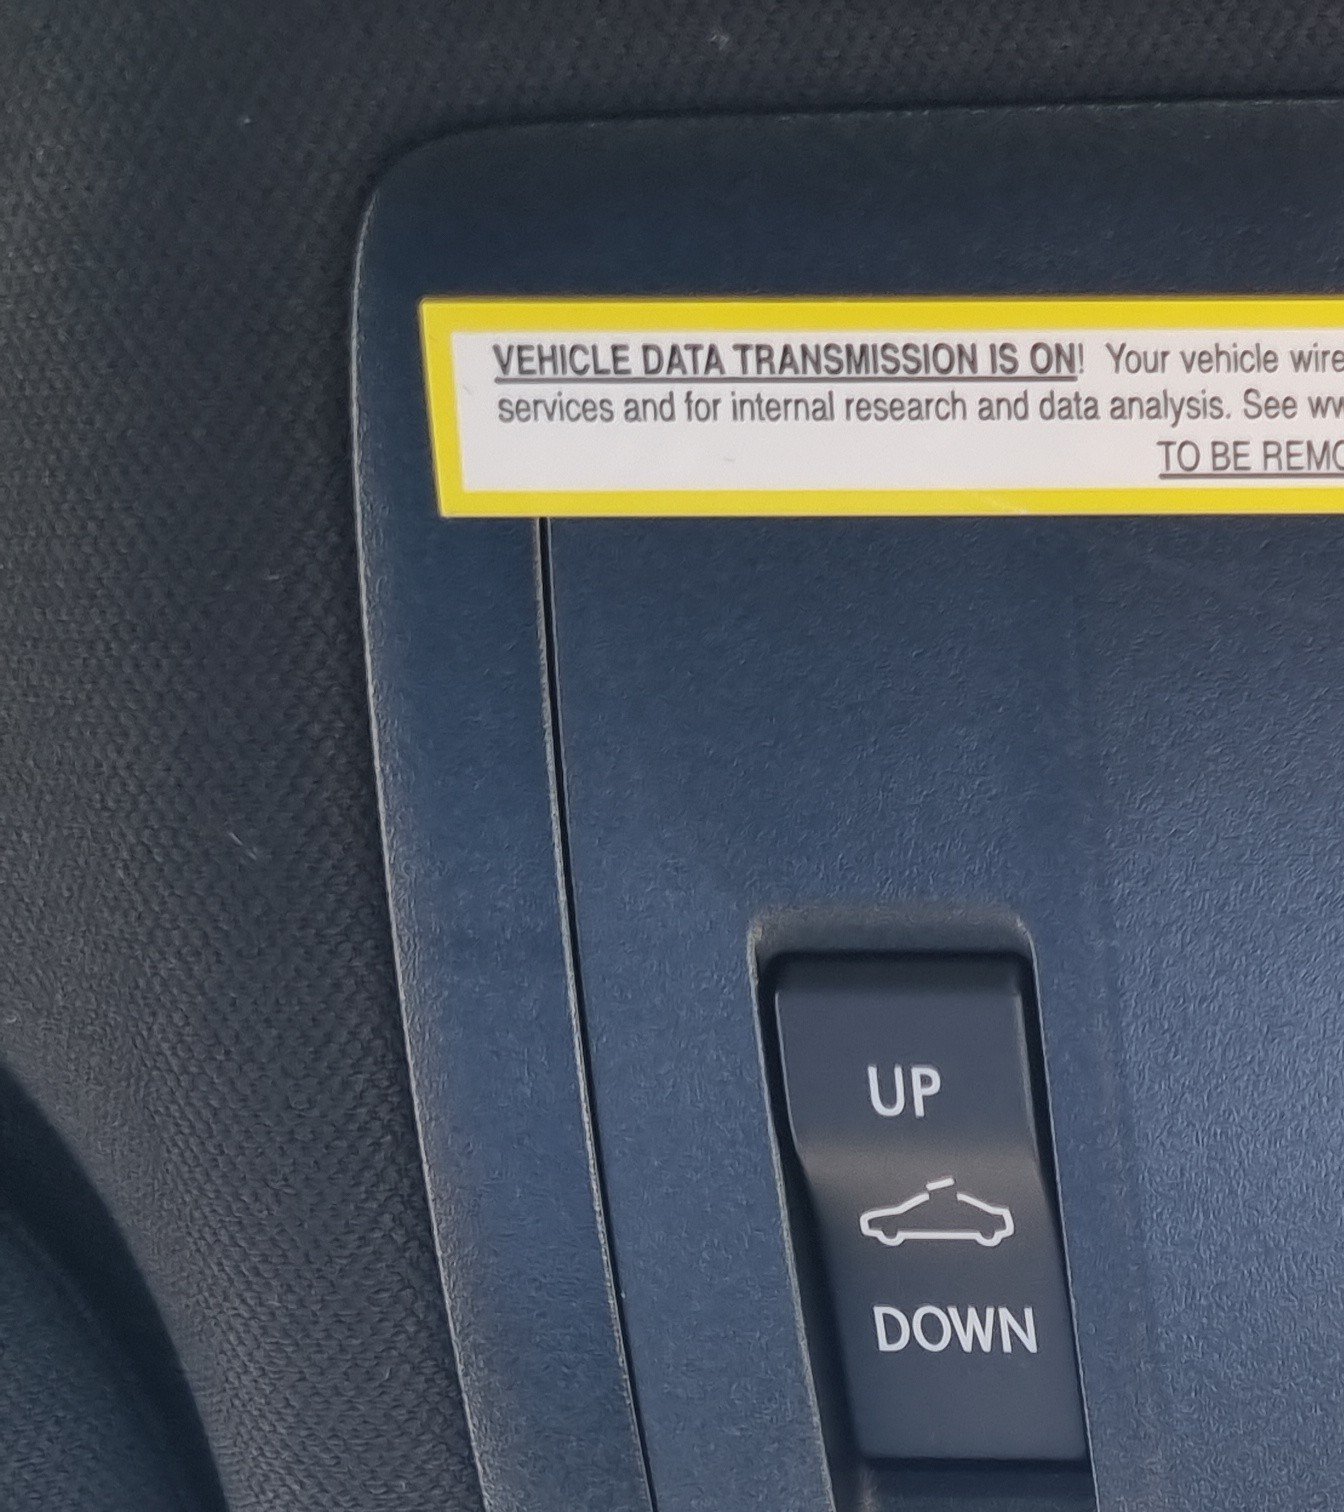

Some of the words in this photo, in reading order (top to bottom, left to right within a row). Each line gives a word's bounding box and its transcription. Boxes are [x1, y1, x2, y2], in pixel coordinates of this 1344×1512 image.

[493, 343, 631, 376] VEHICLE
[643, 343, 727, 376] DATA
[733, 343, 979, 376] TRANSMISSION
[990, 343, 1021, 376] IS
[1028, 342, 1085, 376] ON!
[1104, 342, 1170, 374] Your
[1179, 341, 1279, 374] vehicle
[498, 391, 614, 424] services
[623, 390, 676, 423] and
[684, 389, 722, 423] for
[731, 389, 835, 422] internal
[845, 389, 967, 422] research
[977, 388, 1029, 422] and
[1039, 388, 1101, 422] data
[1110, 388, 1231, 429] analysis.
[1242, 387, 1299, 421] See
[1156, 441, 1202, 474] TO
[1210, 441, 1255, 474] BE
[867, 1064, 942, 1117] UP
[872, 1305, 1039, 1354] DOWN
